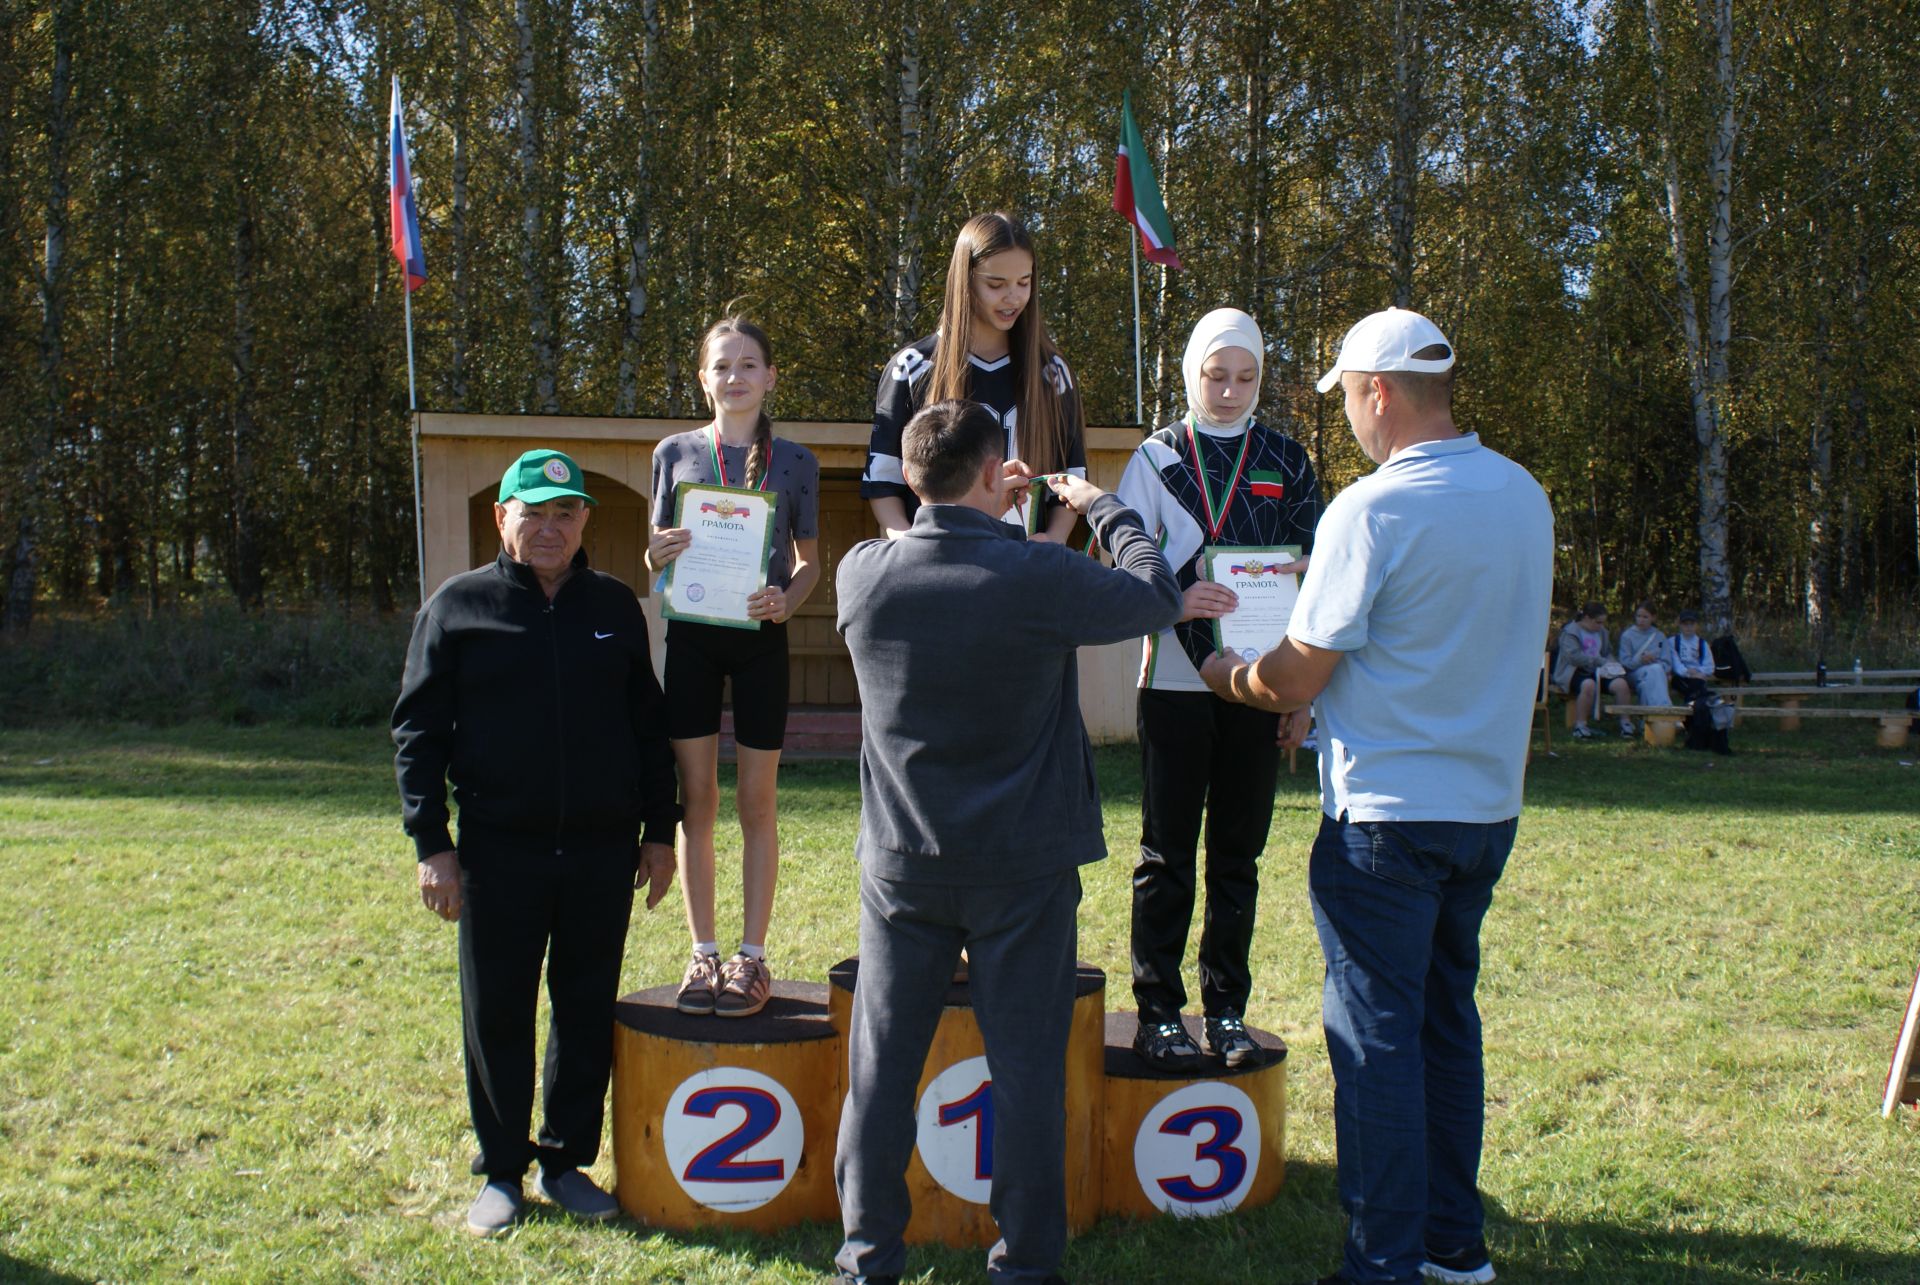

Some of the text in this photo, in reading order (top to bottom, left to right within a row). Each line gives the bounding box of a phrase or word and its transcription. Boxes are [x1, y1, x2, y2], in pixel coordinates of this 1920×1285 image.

[702, 519, 745, 532] ГРАМОТА
[1235, 580, 1279, 589] ГРАМОТА
[683, 1086, 785, 1182] 2
[938, 1080, 995, 1181] 1
[1157, 1105, 1247, 1203] 3
